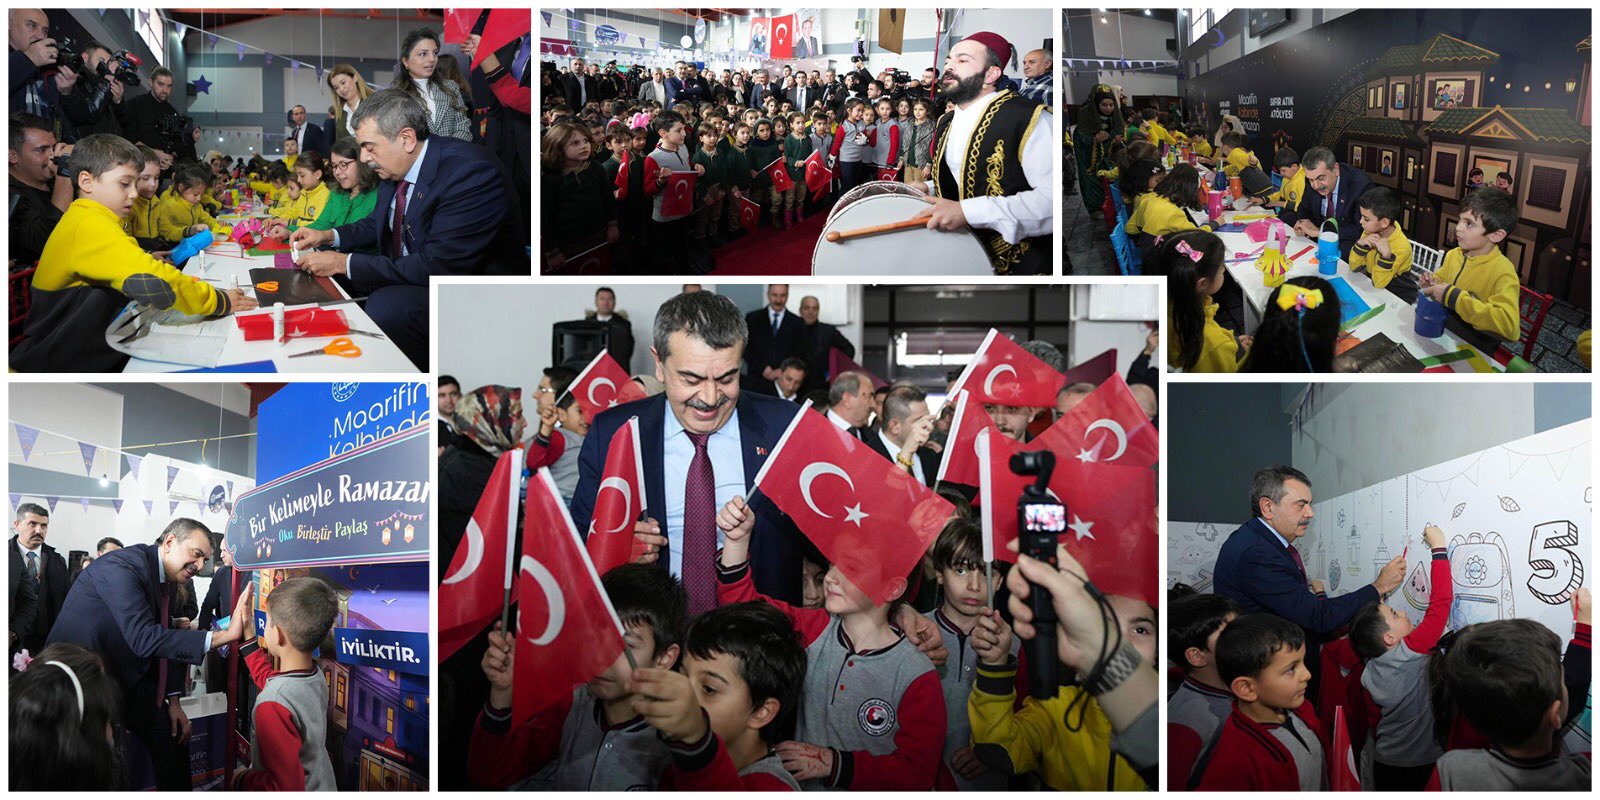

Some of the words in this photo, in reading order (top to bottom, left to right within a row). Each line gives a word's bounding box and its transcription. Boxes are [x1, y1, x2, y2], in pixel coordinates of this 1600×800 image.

[334, 382, 429, 438] Maarifin
[249, 513, 266, 538] Bir
[269, 482, 335, 526] Kelimeyle
[278, 529, 293, 543] Oku
[297, 525, 332, 543] Birleştir
[335, 520, 368, 540] Paylaş
[1526, 519, 1585, 605] 5
[341, 637, 421, 664] İYİLİKTİR.
